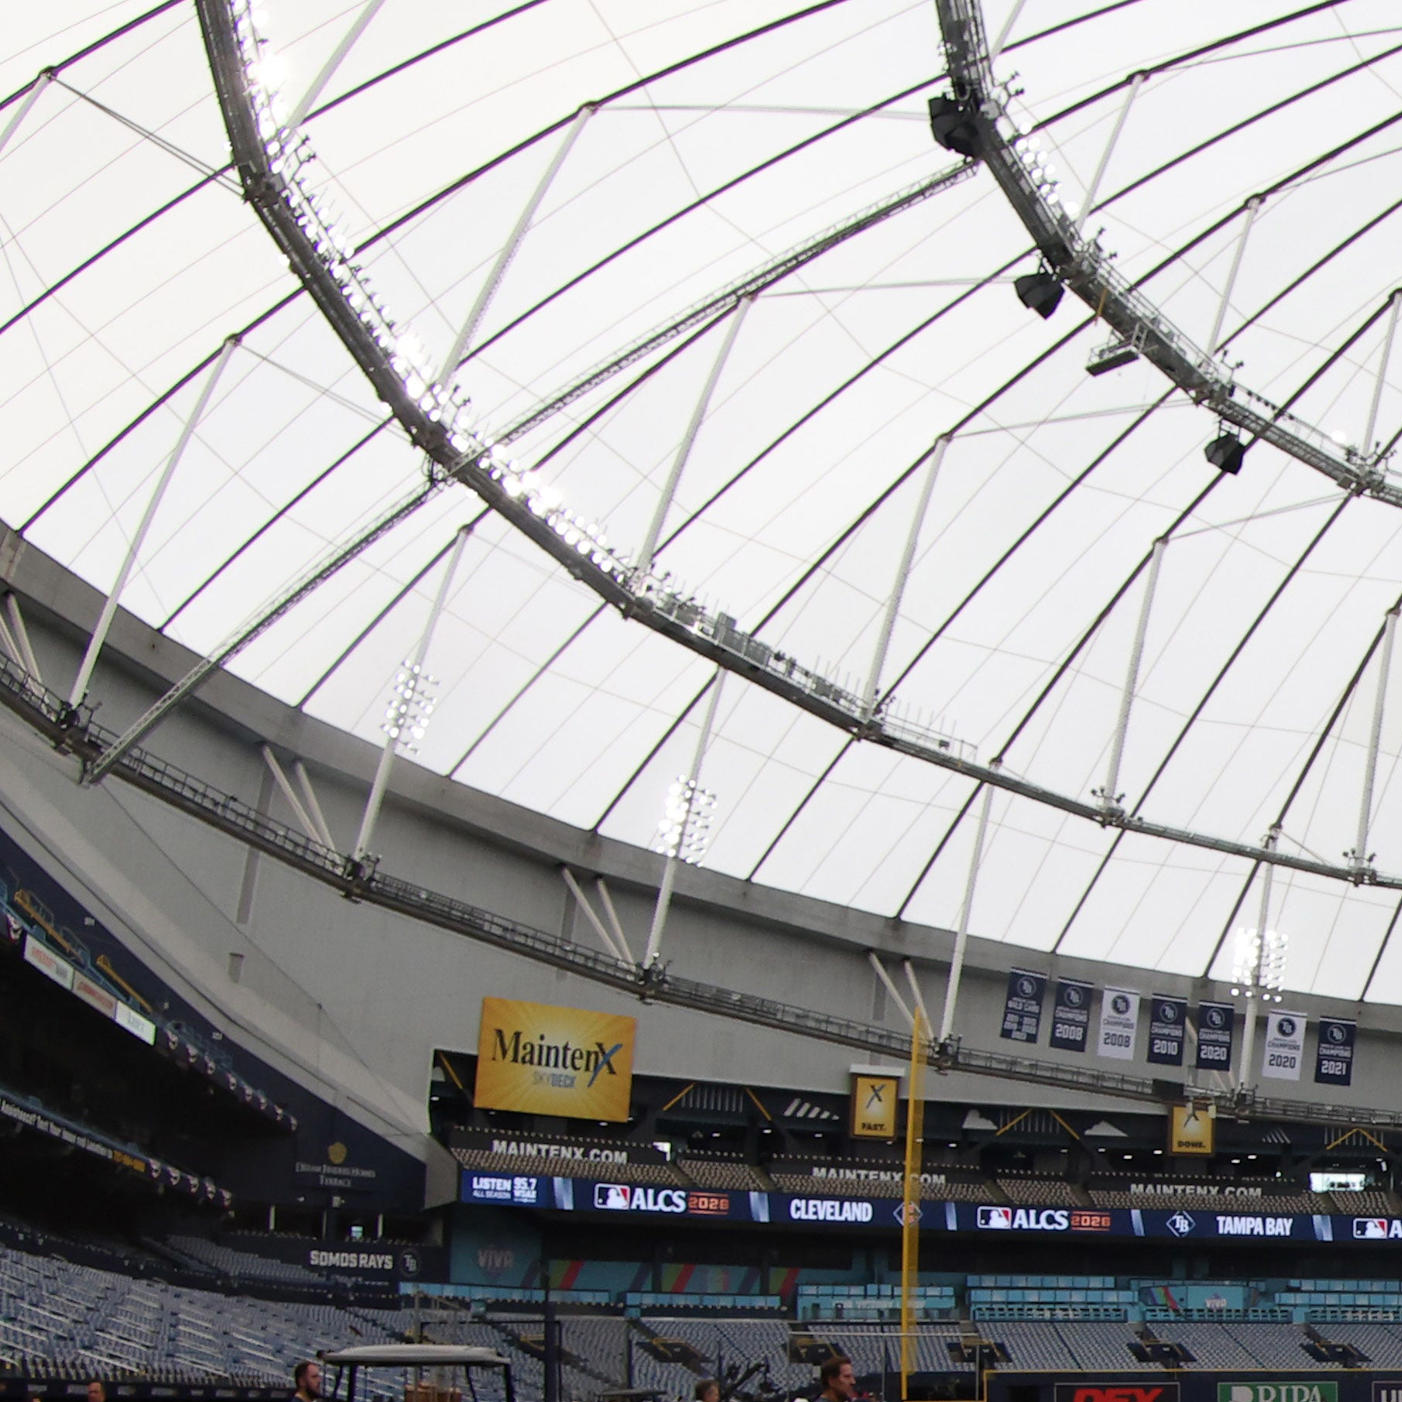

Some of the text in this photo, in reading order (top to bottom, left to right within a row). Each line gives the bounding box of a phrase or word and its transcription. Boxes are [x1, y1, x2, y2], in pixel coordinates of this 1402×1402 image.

[1055, 1023, 1083, 1041] 2008
[1104, 1032, 1131, 1048] 2008
[1153, 1039, 1178, 1055] 2010
[1200, 1045, 1227, 1061] 2020
[492, 1028, 623, 1088] MaintenX
[1269, 1053, 1296, 1069] 2020
[1321, 1060, 1346, 1075] 2021
[491, 1139, 628, 1165] MAINTENX.COM
[473, 1176, 512, 1191] LISTEN
[630, 1188, 686, 1213] ALCS
[790, 1198, 873, 1222] CLEVELAND
[1013, 1209, 1070, 1231] ALCS
[1217, 1216, 1293, 1236] TAMPA BAY
[310, 1250, 393, 1270] SOMOS RAYS
